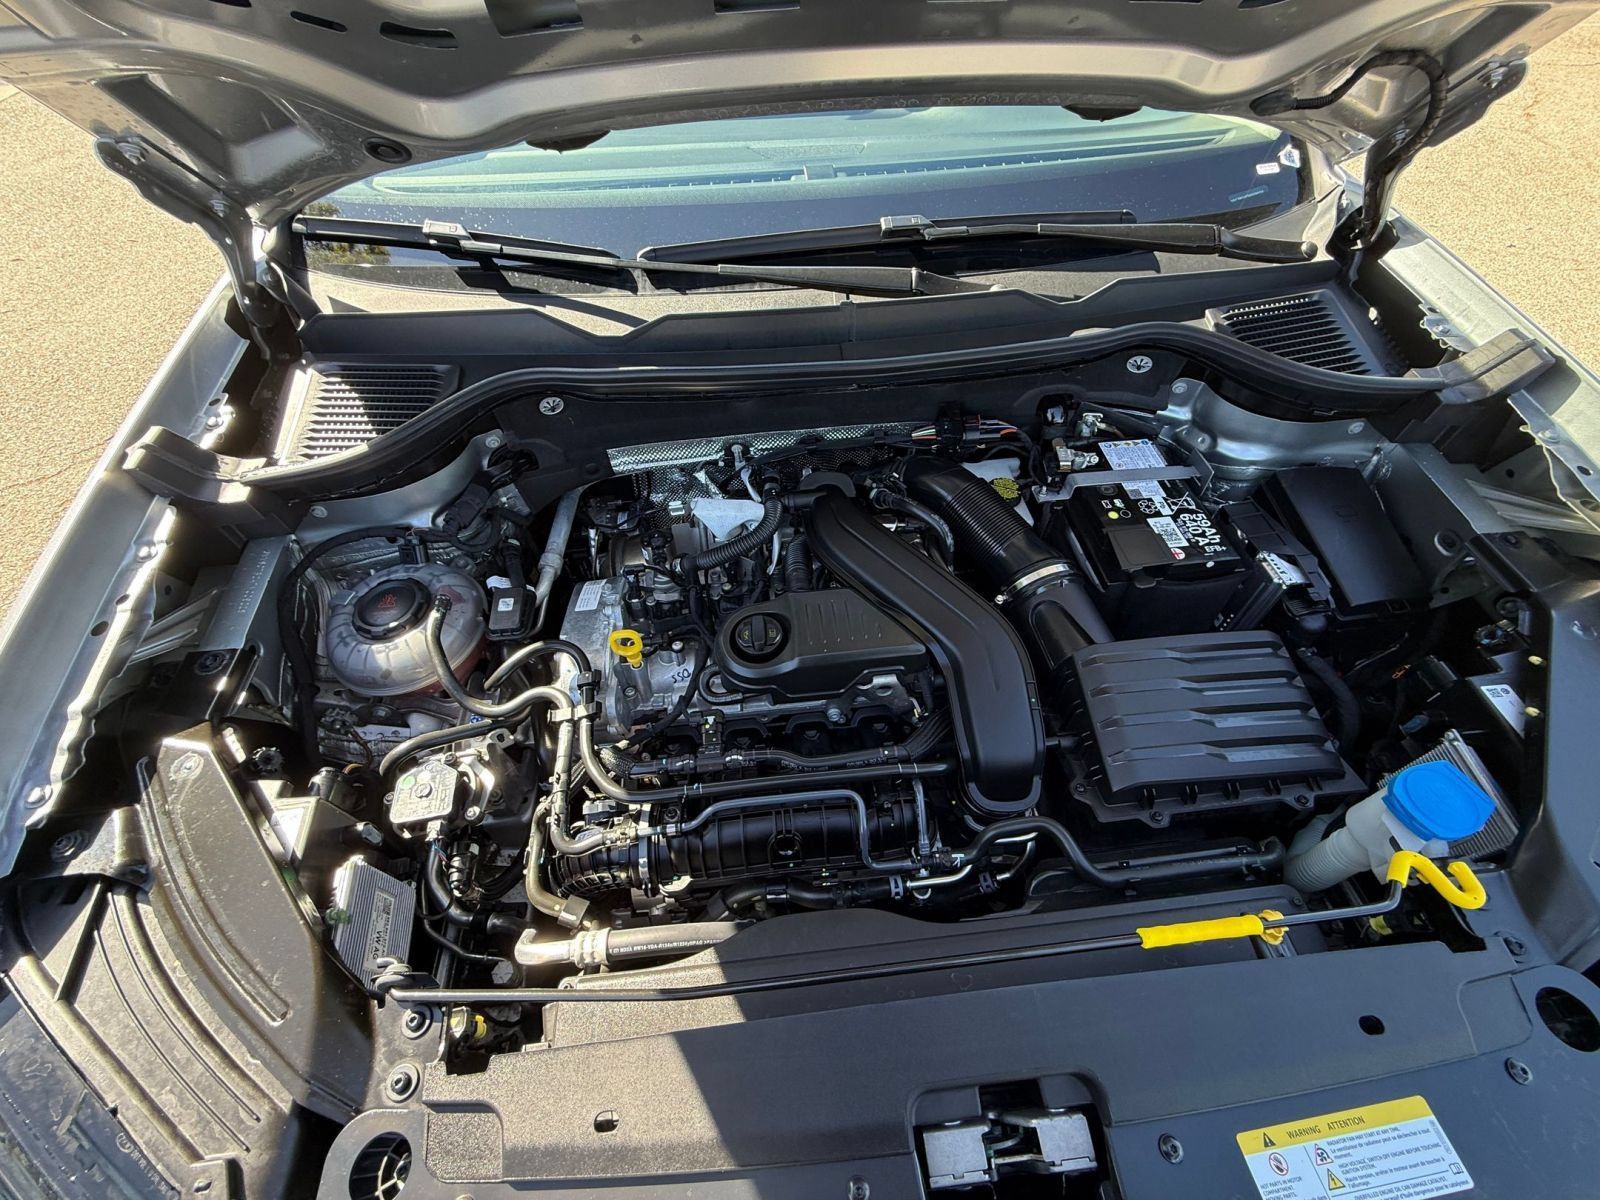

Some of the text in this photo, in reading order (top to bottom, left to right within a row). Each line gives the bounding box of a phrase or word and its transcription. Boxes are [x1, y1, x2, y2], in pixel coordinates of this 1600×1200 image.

[1180, 513, 1203, 534] 640
[1193, 513, 1221, 543] 59Ah
[1286, 1116, 1366, 1139] WARNING ATTENTION
[1327, 1138, 1346, 1146] RADIATOR
